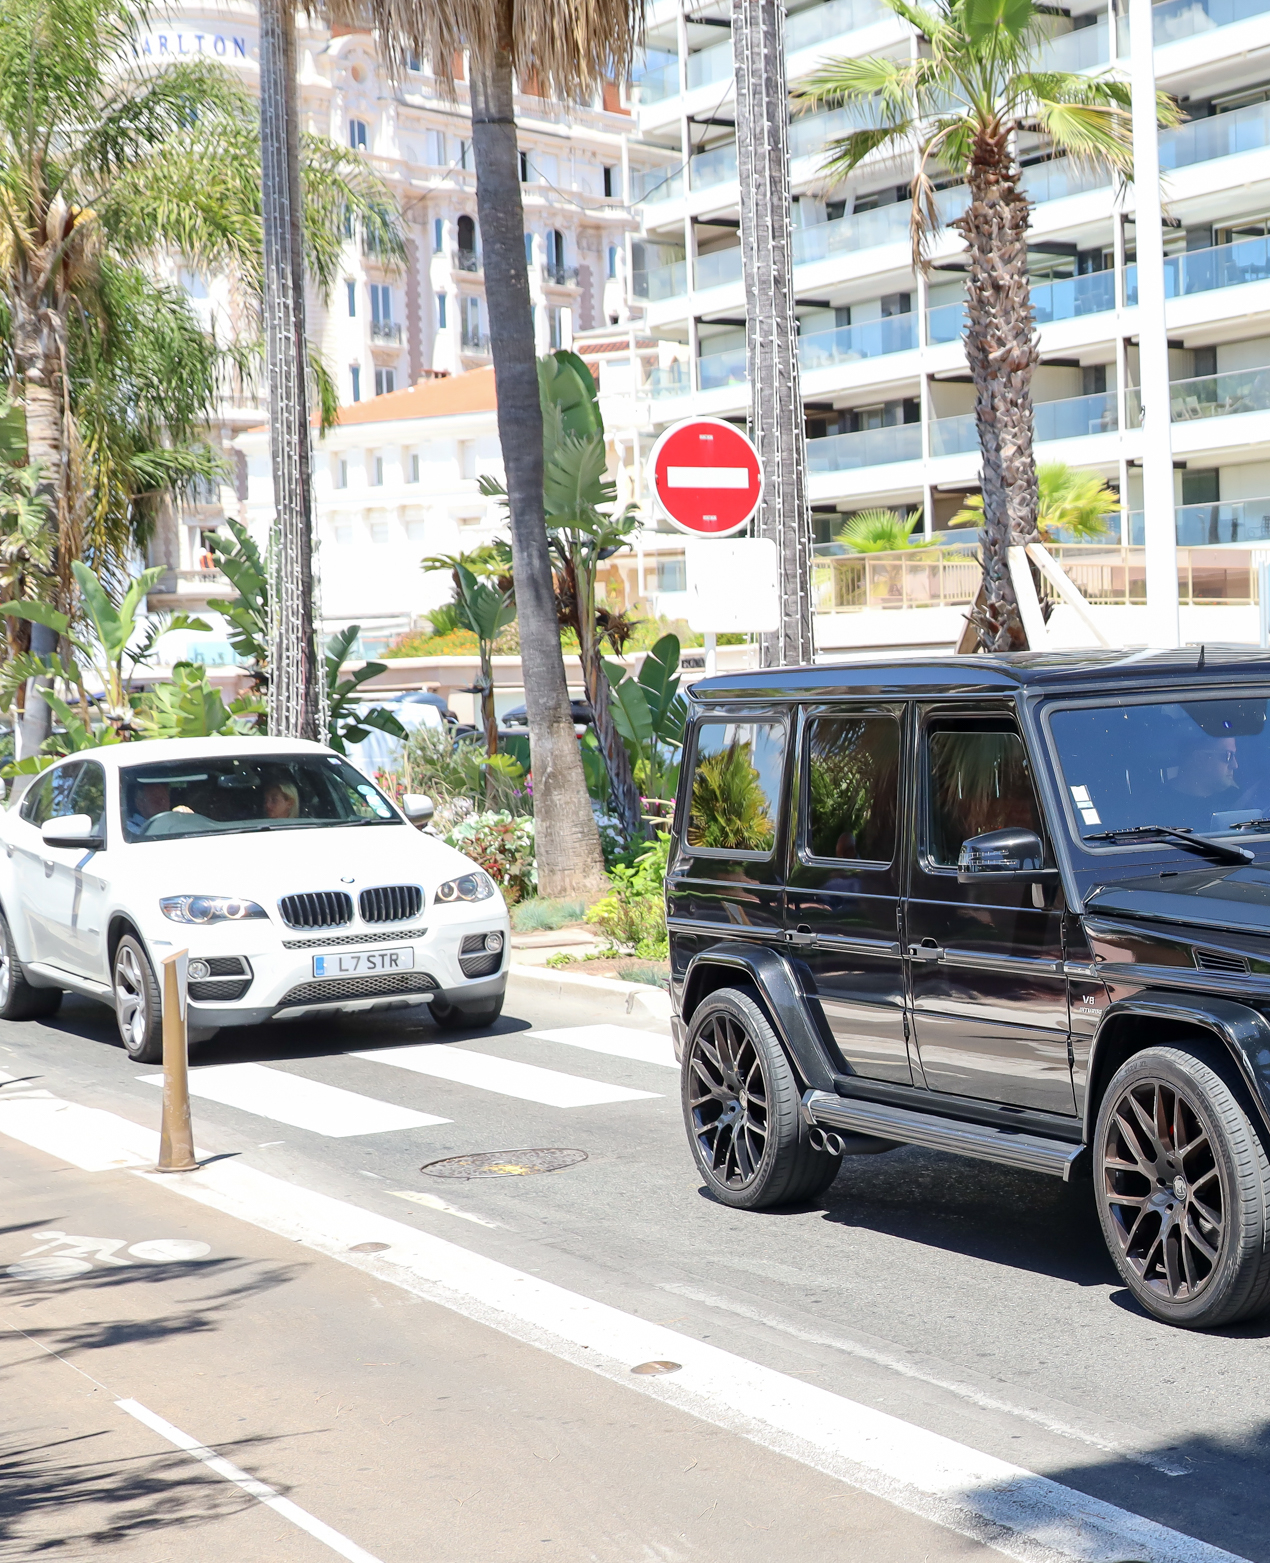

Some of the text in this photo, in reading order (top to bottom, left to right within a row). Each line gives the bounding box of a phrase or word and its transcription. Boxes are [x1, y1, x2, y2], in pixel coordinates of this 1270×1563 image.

[339, 952, 399, 972] L7 STR
[1082, 995, 1095, 1005] V8
